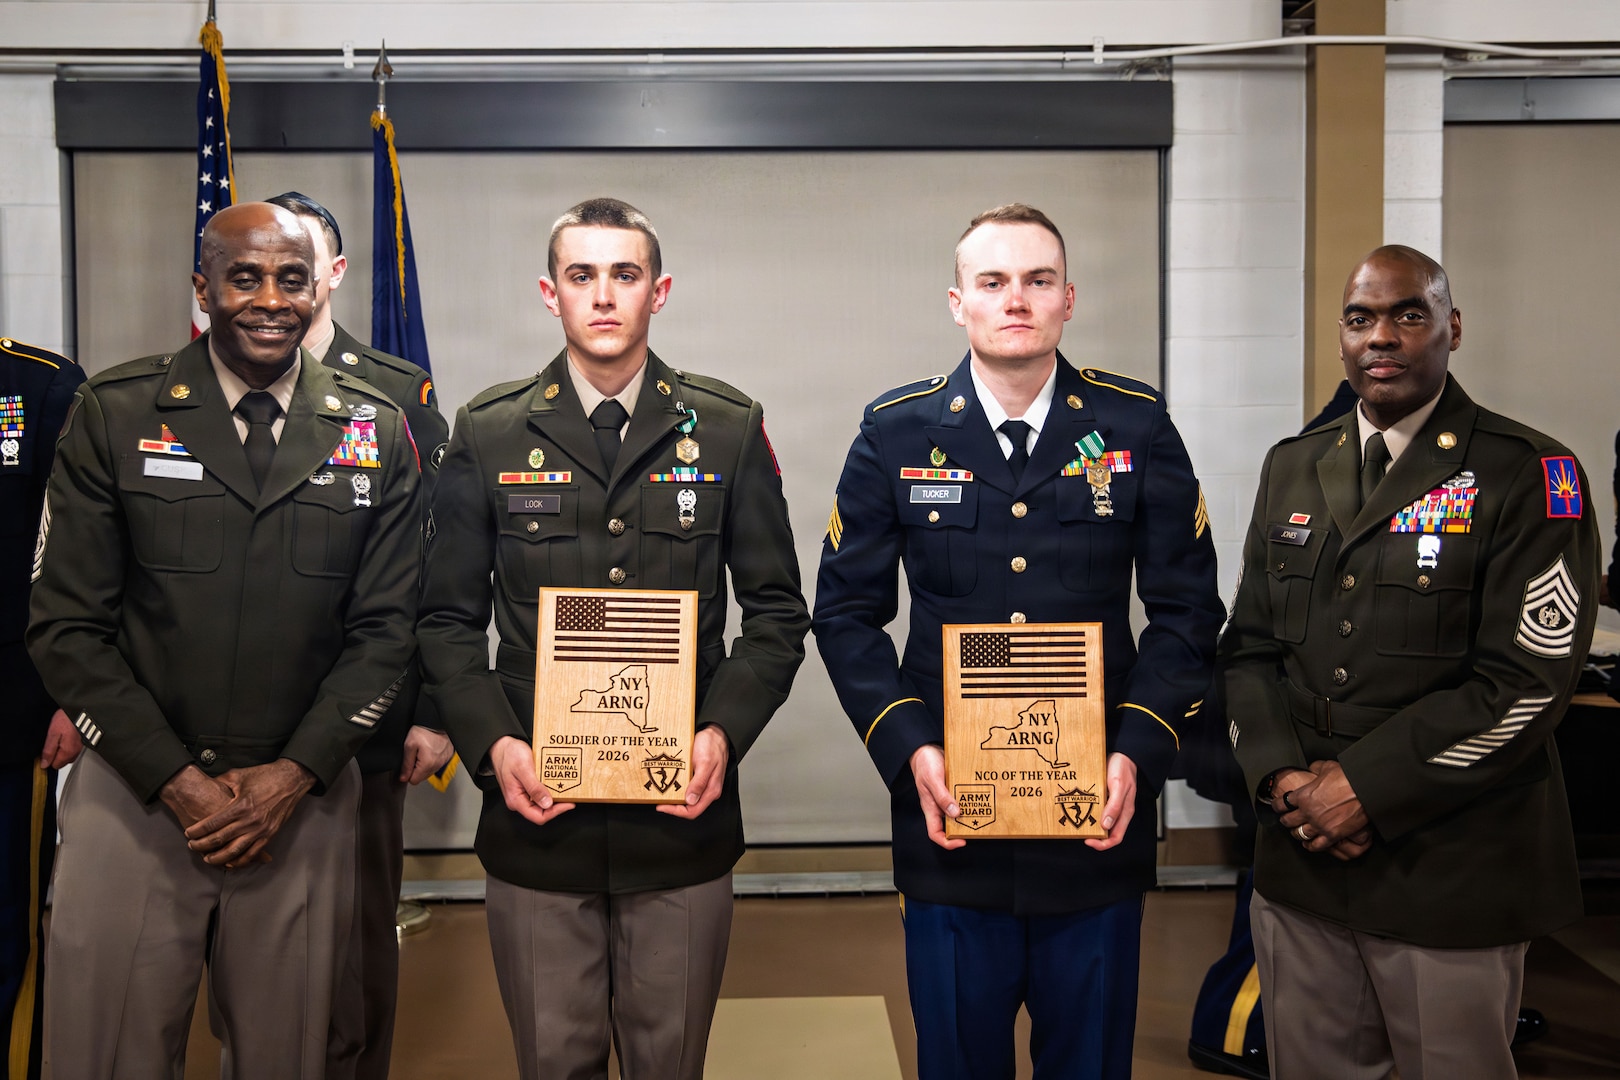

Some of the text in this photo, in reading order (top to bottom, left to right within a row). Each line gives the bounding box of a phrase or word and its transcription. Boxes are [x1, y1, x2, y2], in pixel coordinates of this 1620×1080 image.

[922, 489, 949, 499] TUCKER
[525, 500, 543, 508] LOCK
[620, 677, 643, 691] NY
[597, 695, 644, 710] ARNG
[1028, 713, 1051, 726] NY
[549, 735, 678, 747] SOLDIER OF THE YEAR
[1007, 731, 1054, 745] ARNG
[546, 756, 578, 765] ARMY
[597, 750, 630, 762] 2026
[544, 770, 579, 779] GUARD
[974, 770, 1077, 781] NCO OF THE YEAR
[1010, 786, 1043, 797] 2026
[959, 793, 991, 802] ARMY
[959, 807, 992, 816] GUARD
